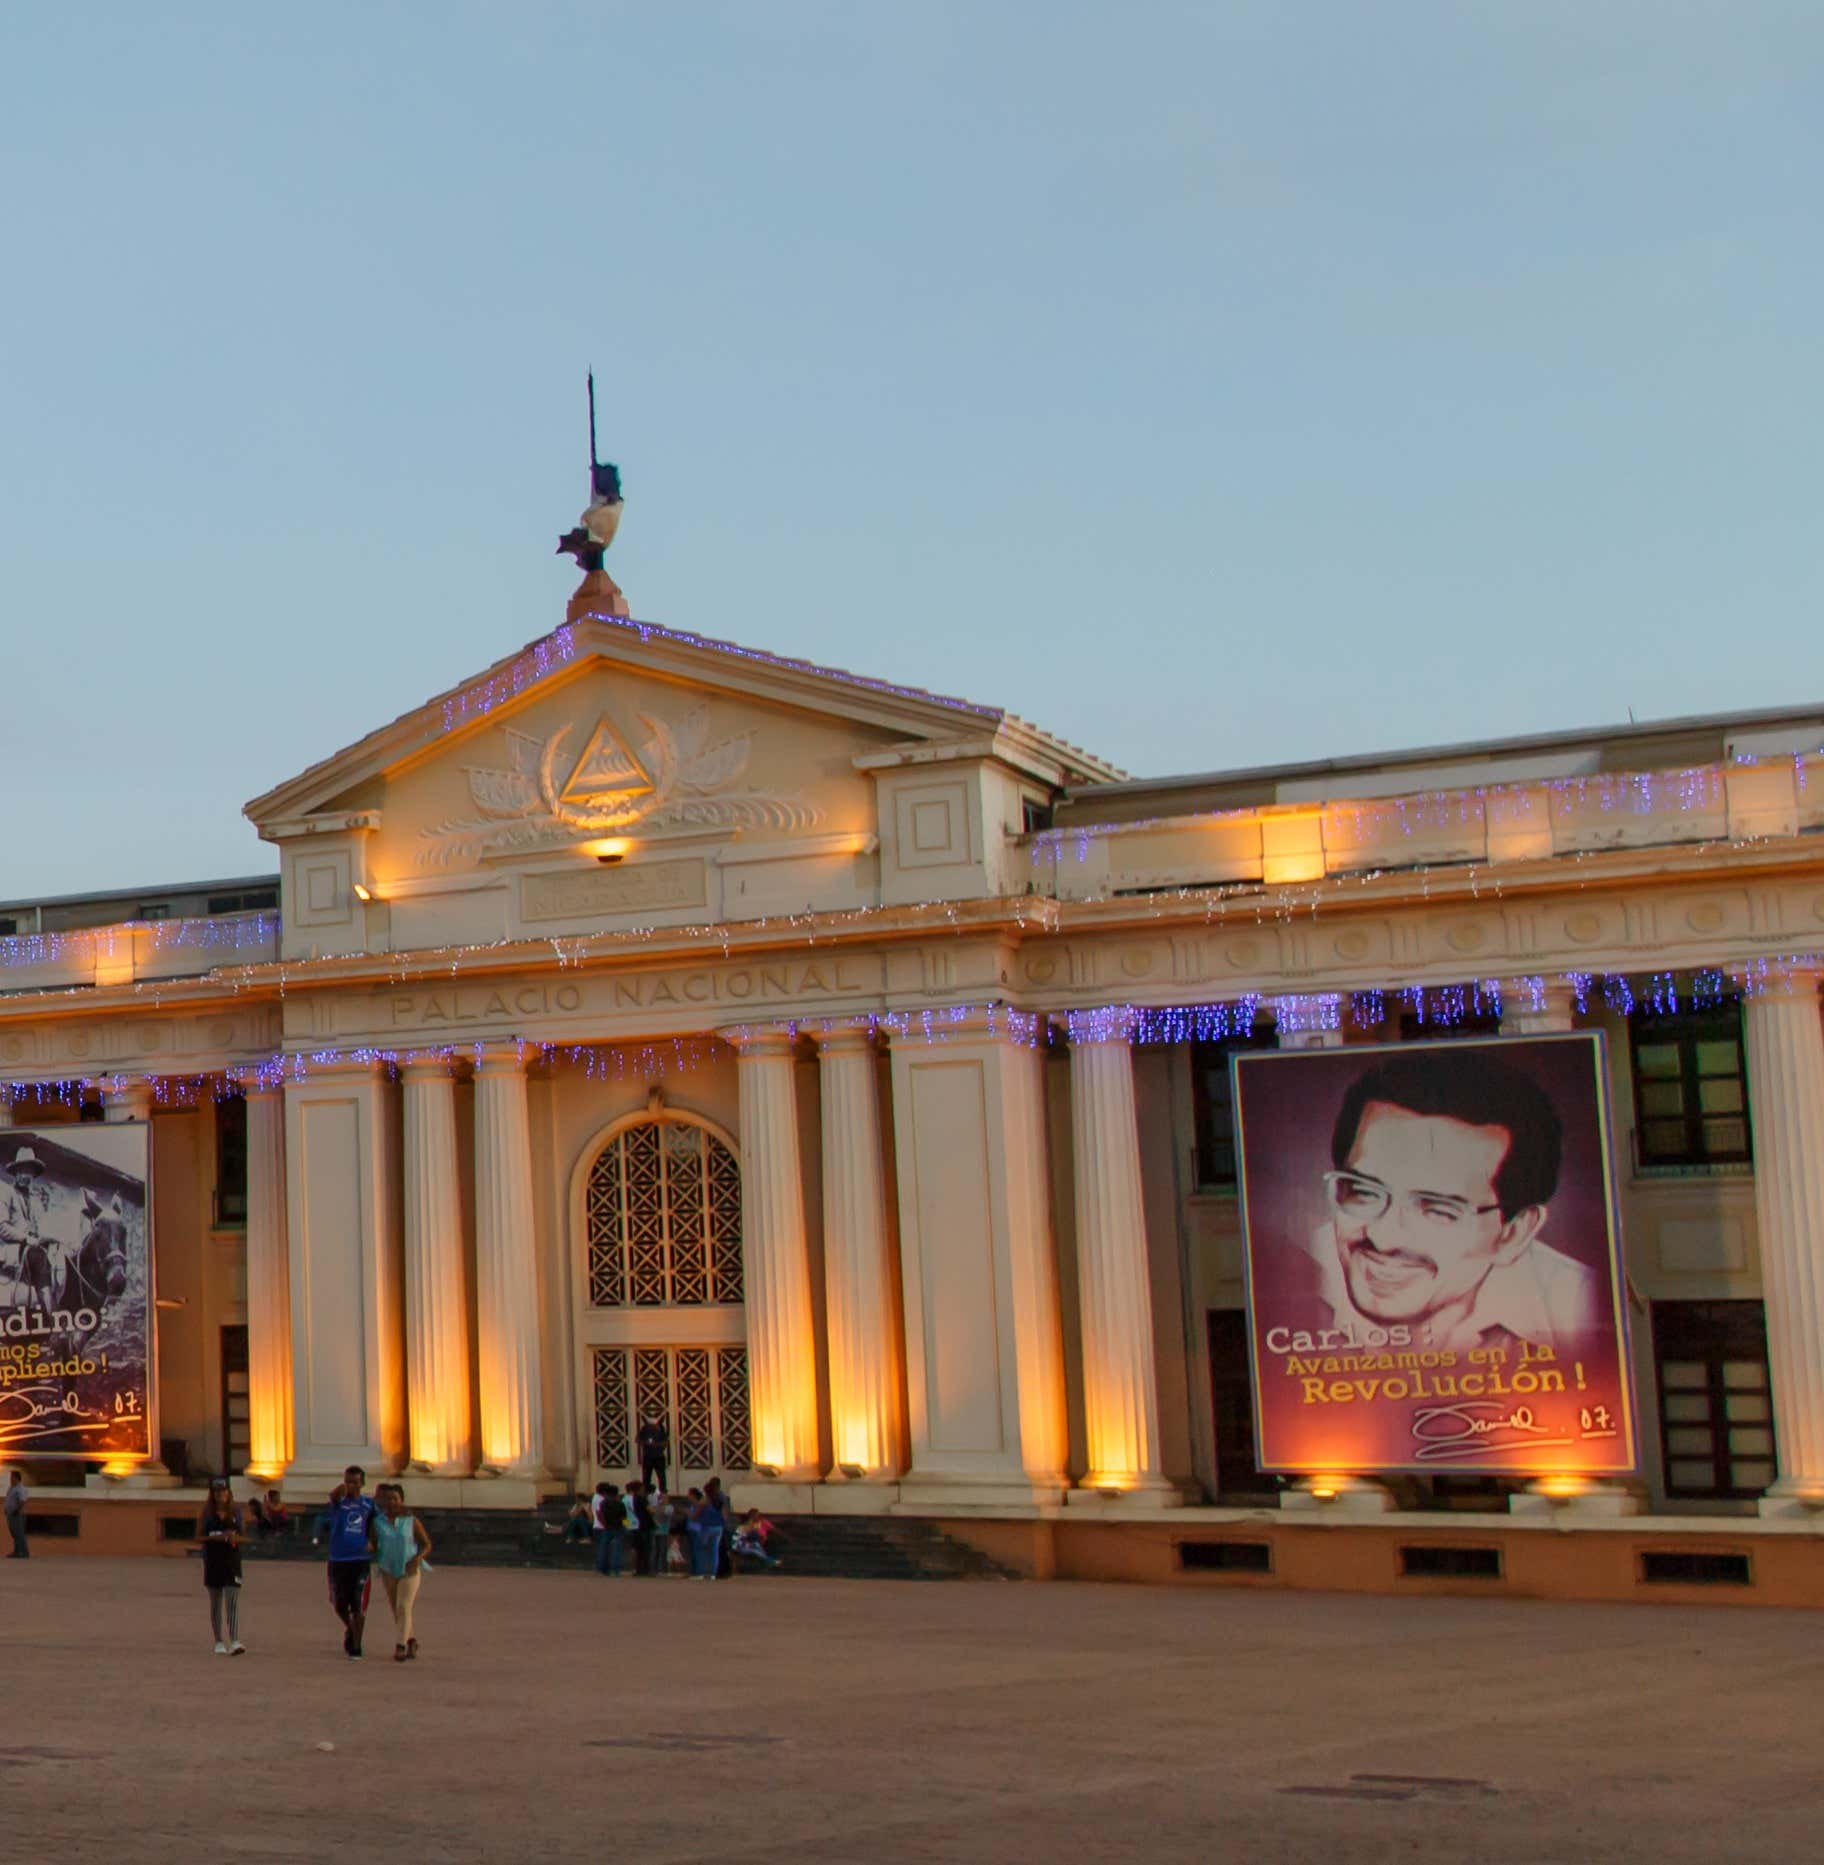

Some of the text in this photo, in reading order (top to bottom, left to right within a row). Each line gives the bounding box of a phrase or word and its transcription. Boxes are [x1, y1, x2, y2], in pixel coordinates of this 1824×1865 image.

[391, 962, 861, 1026] PALACIO NACIONAL
[1285, 1341, 1555, 1377] Avanzamos en la
